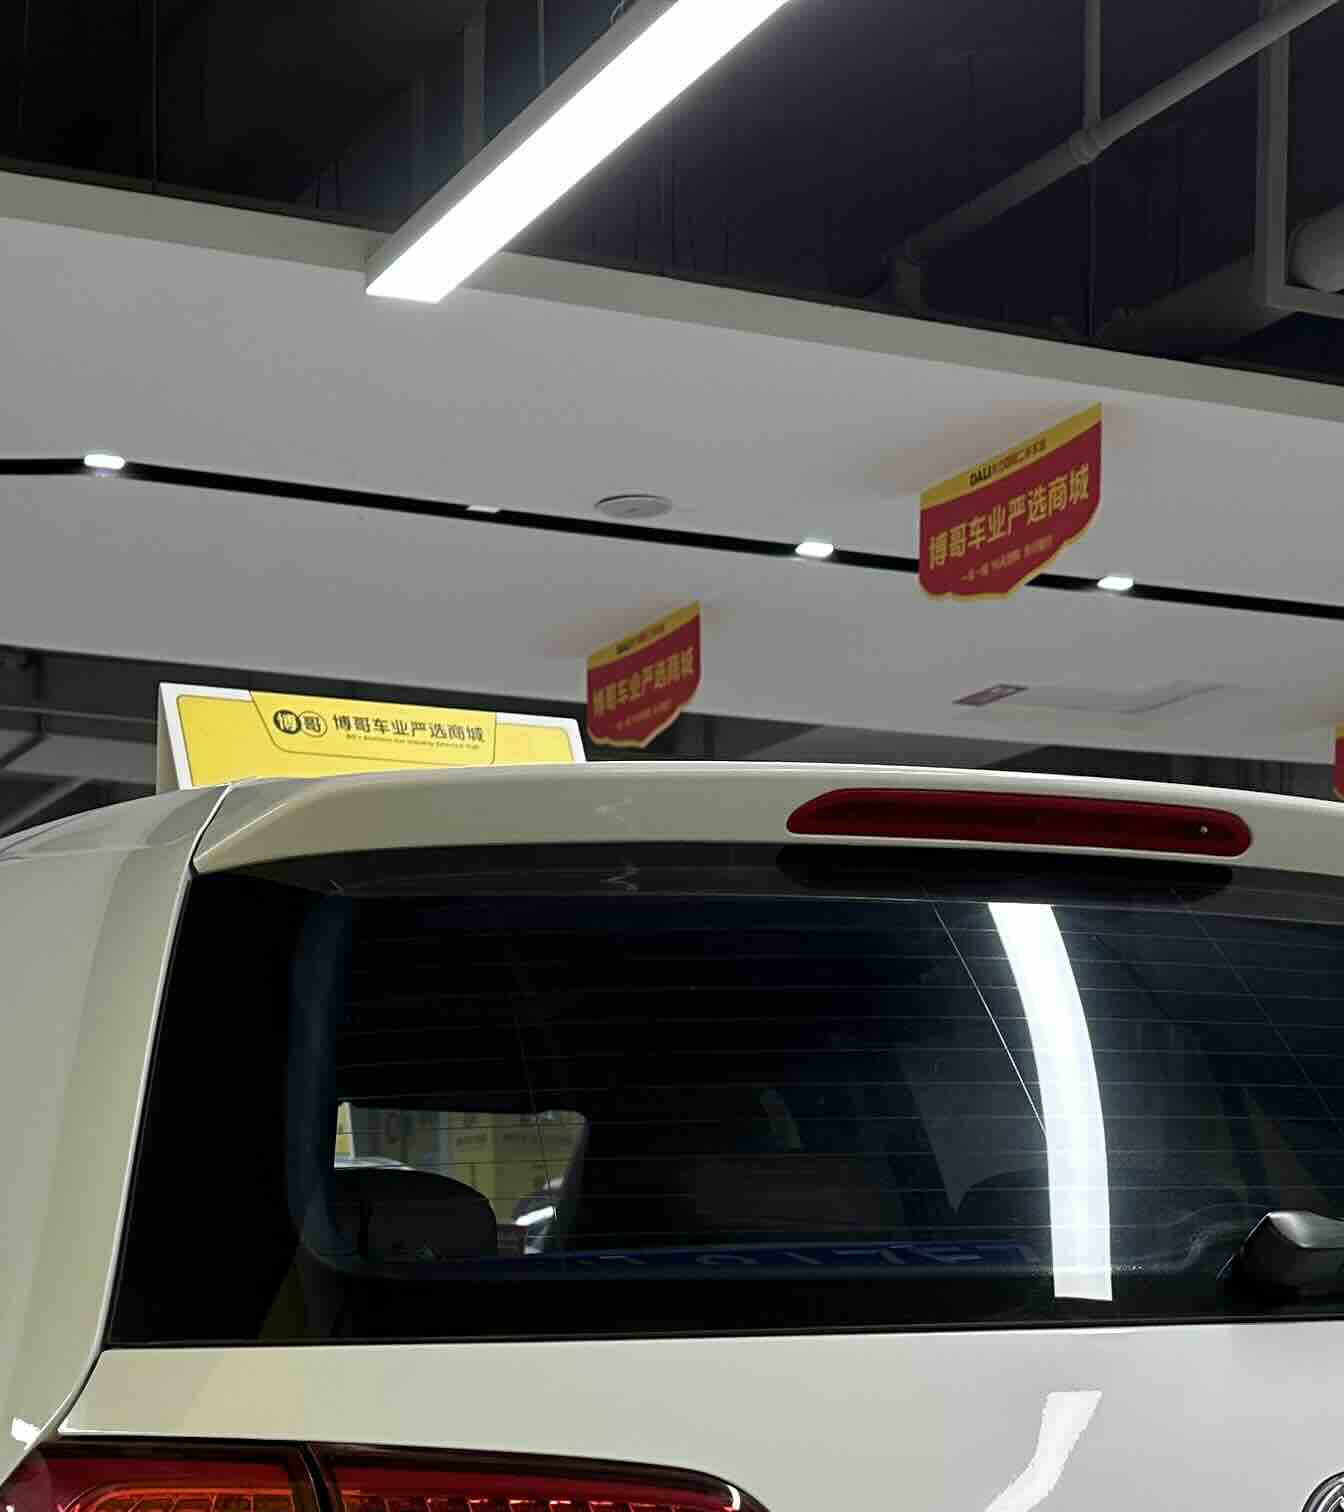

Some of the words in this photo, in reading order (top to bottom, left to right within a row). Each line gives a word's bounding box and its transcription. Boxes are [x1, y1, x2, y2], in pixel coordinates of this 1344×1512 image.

[928, 463, 1090, 570] 博哥车业严选商城
[333, 713, 486, 743] 博哥车业严选商城
